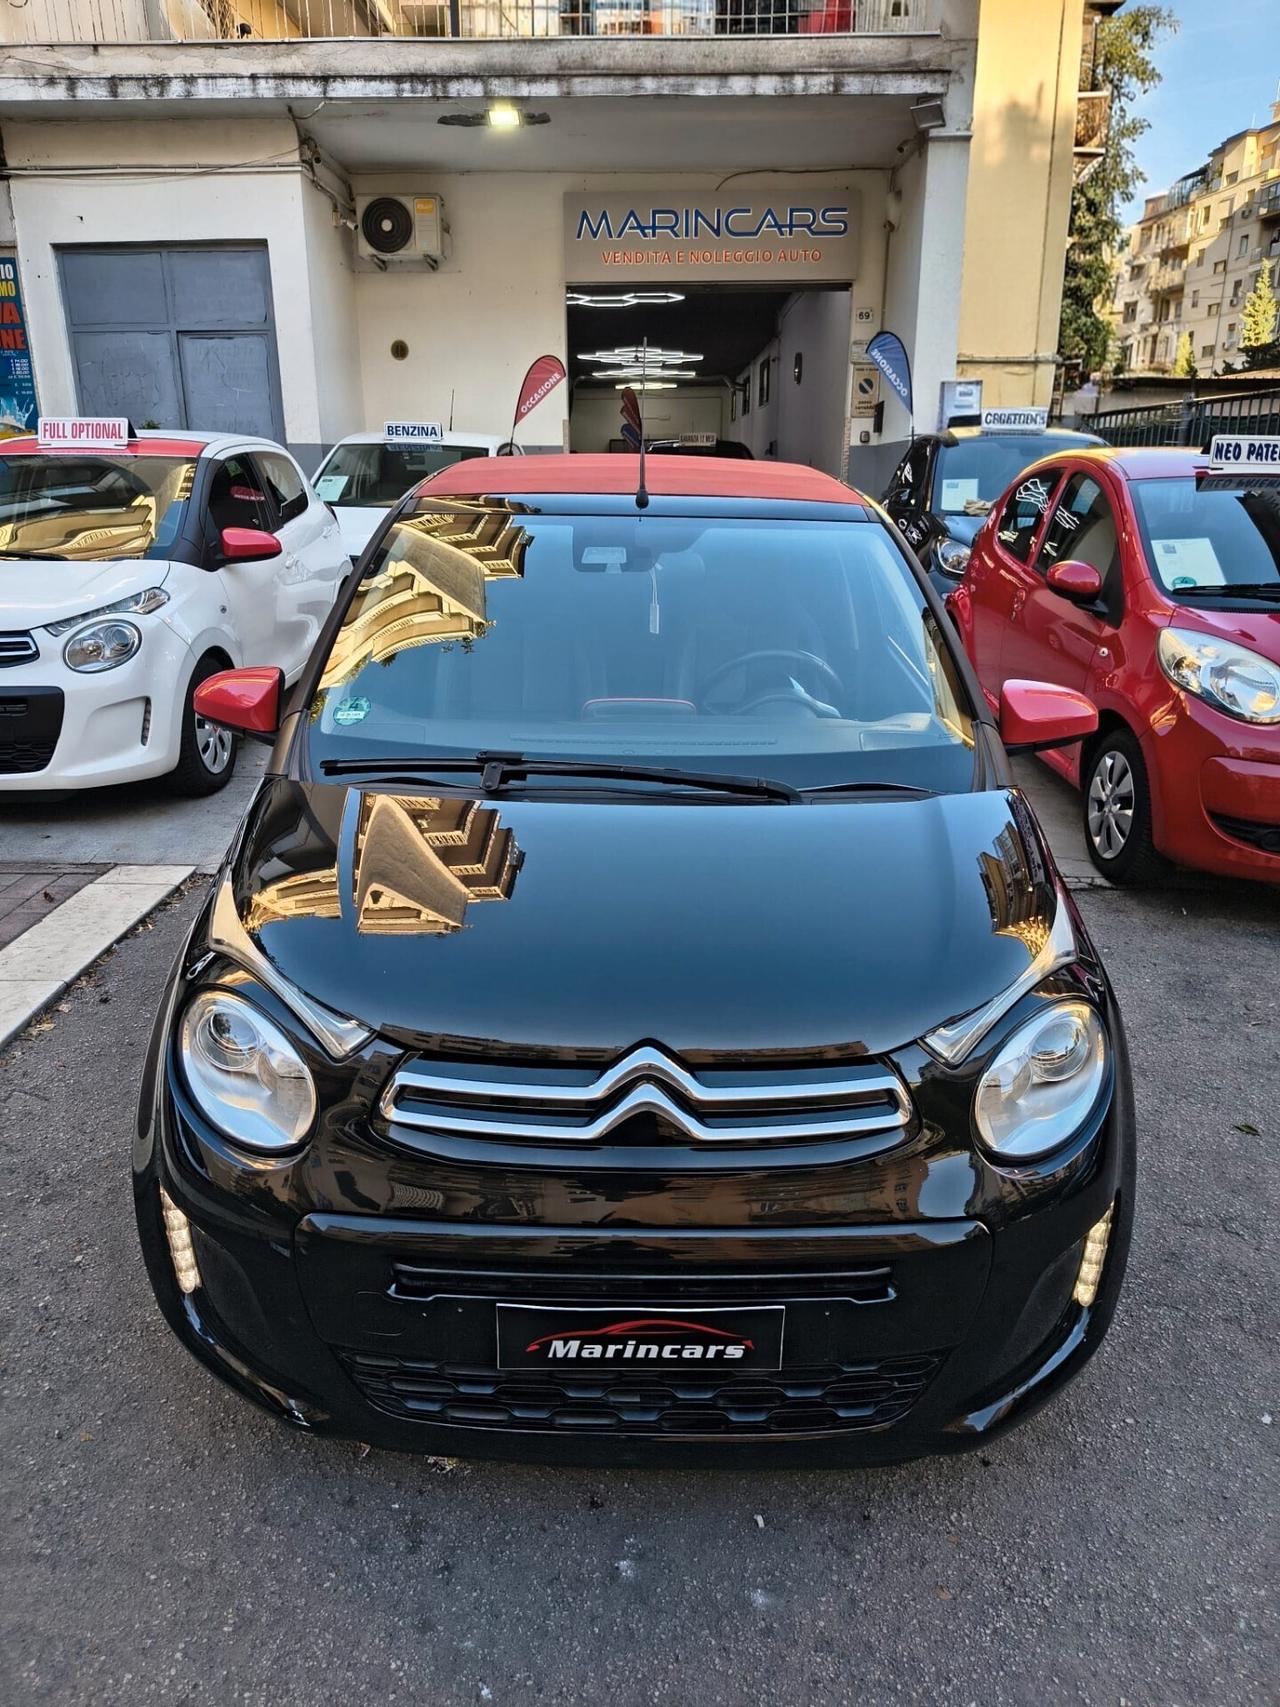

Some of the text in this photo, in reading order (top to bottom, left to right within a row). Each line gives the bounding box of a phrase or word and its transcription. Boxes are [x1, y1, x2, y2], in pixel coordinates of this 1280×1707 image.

[576, 207, 849, 240] MARINCARS
[601, 248, 823, 265] VENDITA E NOLEGGIO AUTO
[858, 311, 870, 320] 69
[520, 372, 561, 414] OCCASIONE
[43, 422, 123, 439] FULL OPTIONAL
[387, 425, 438, 437] BENZINA
[1214, 442, 1280, 462] NEO PATE
[547, 1340, 746, 1359] Marincars
